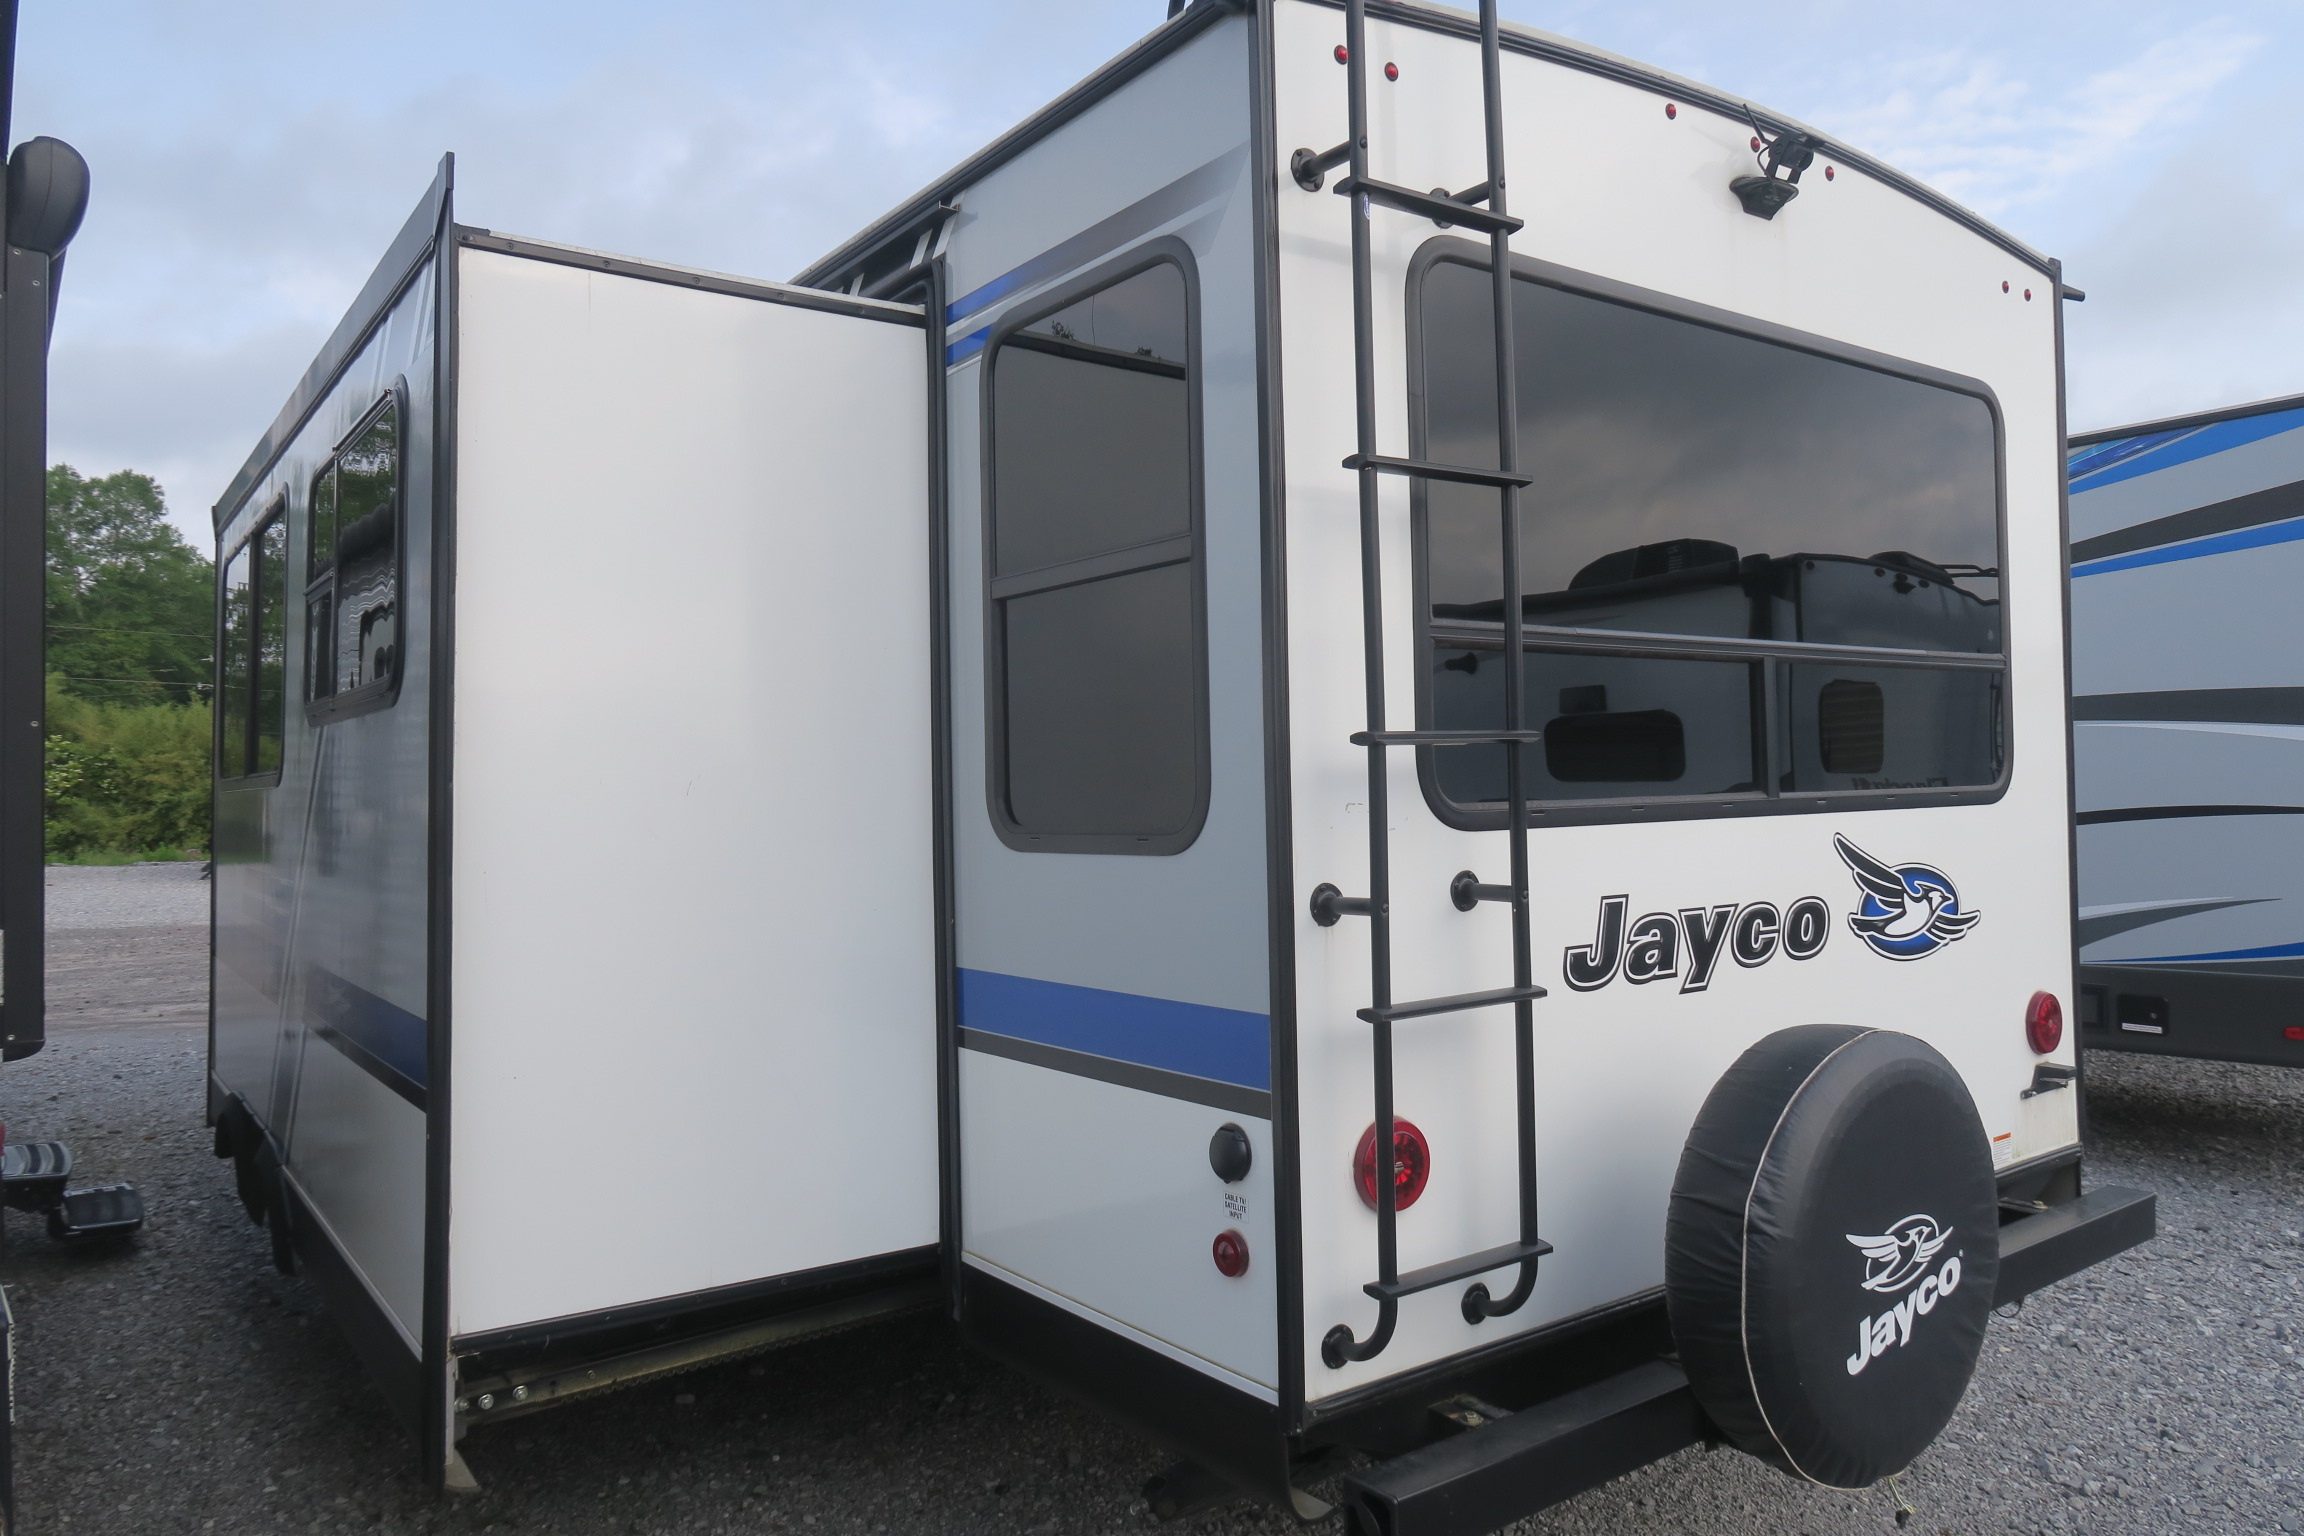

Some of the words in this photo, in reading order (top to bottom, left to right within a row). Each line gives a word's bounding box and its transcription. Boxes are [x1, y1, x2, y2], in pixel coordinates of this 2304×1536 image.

[1563, 894, 1830, 994] Jayco
[1225, 1192, 1238, 1202] CABLE
[1225, 1200, 1246, 1213] SATELLITE
[1229, 1210, 1242, 1219] INPUT
[1847, 1256, 1961, 1376] Jayco
